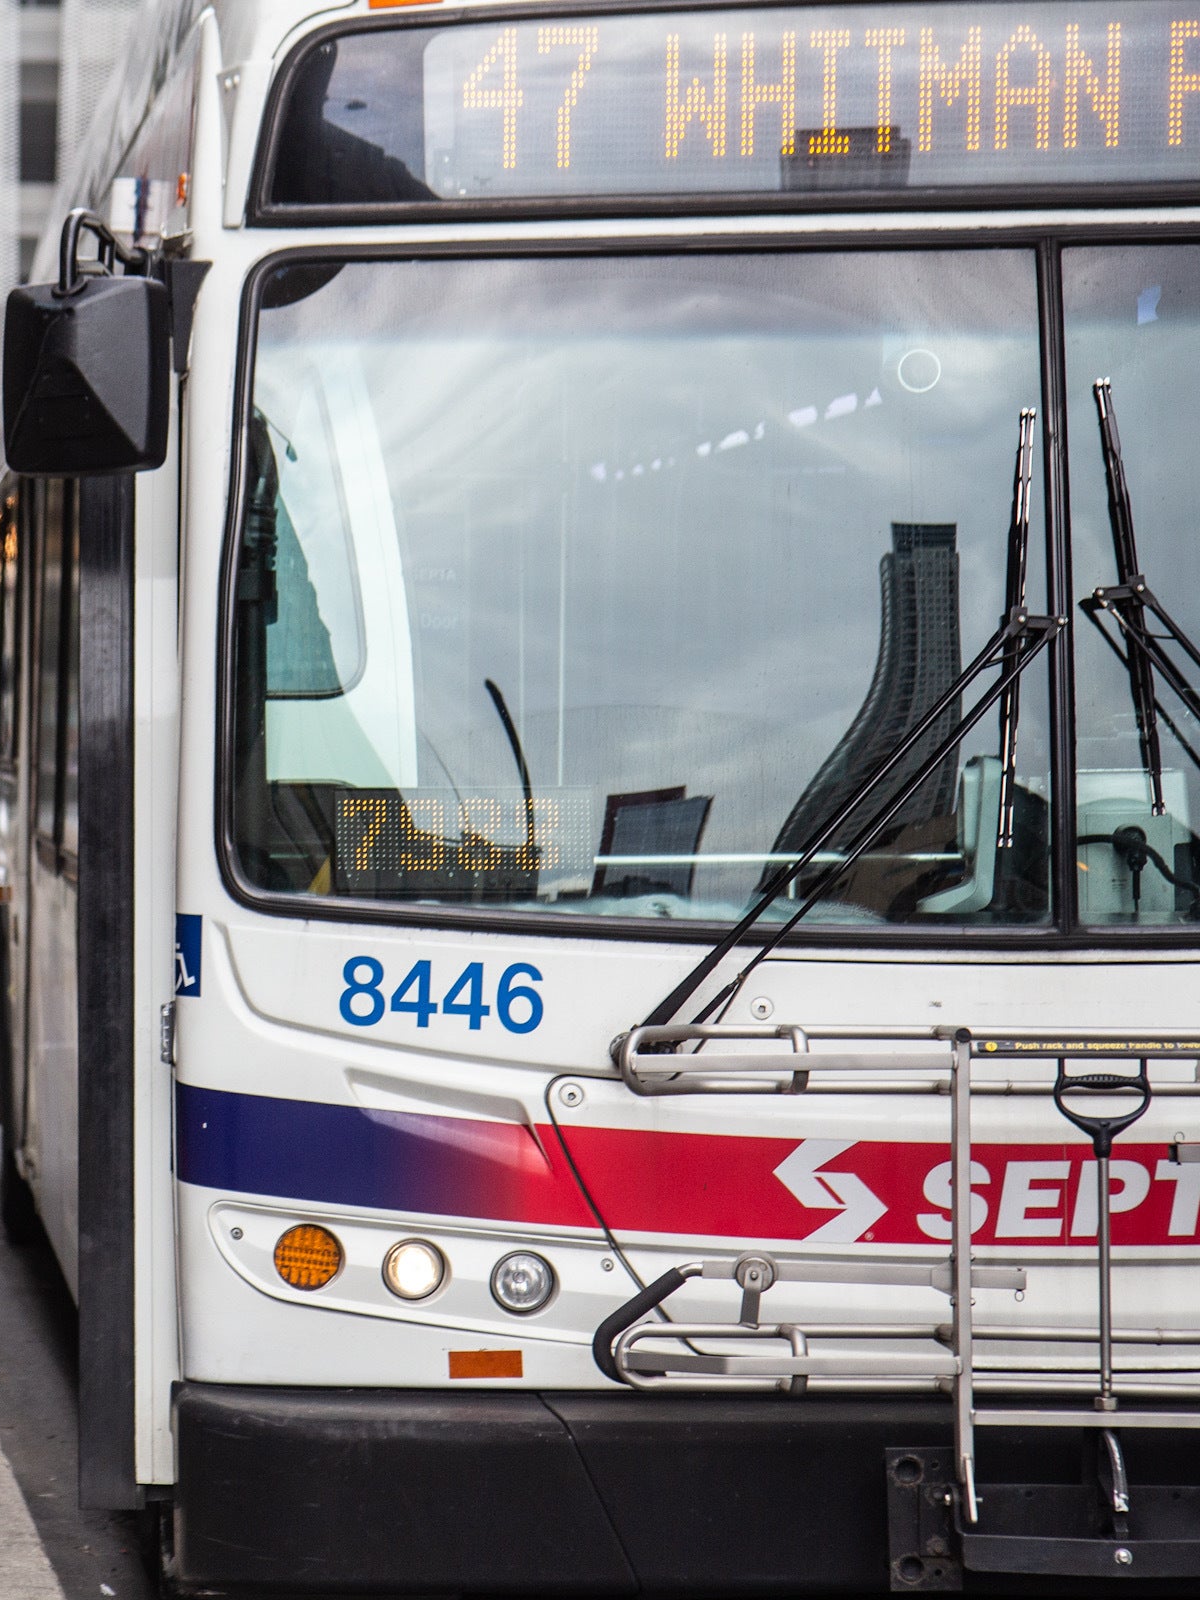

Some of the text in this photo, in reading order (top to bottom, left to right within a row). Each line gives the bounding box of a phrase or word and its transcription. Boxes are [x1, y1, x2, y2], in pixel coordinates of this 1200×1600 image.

[464, 26, 598, 169] 47
[666, 23, 1121, 157] WHITMAN
[339, 956, 543, 1034] 8446
[1014, 1041, 1039, 1050] Push
[1042, 1042, 1063, 1050] rack
[1066, 1042, 1084, 1050] and
[1087, 1042, 1126, 1051] squeeze
